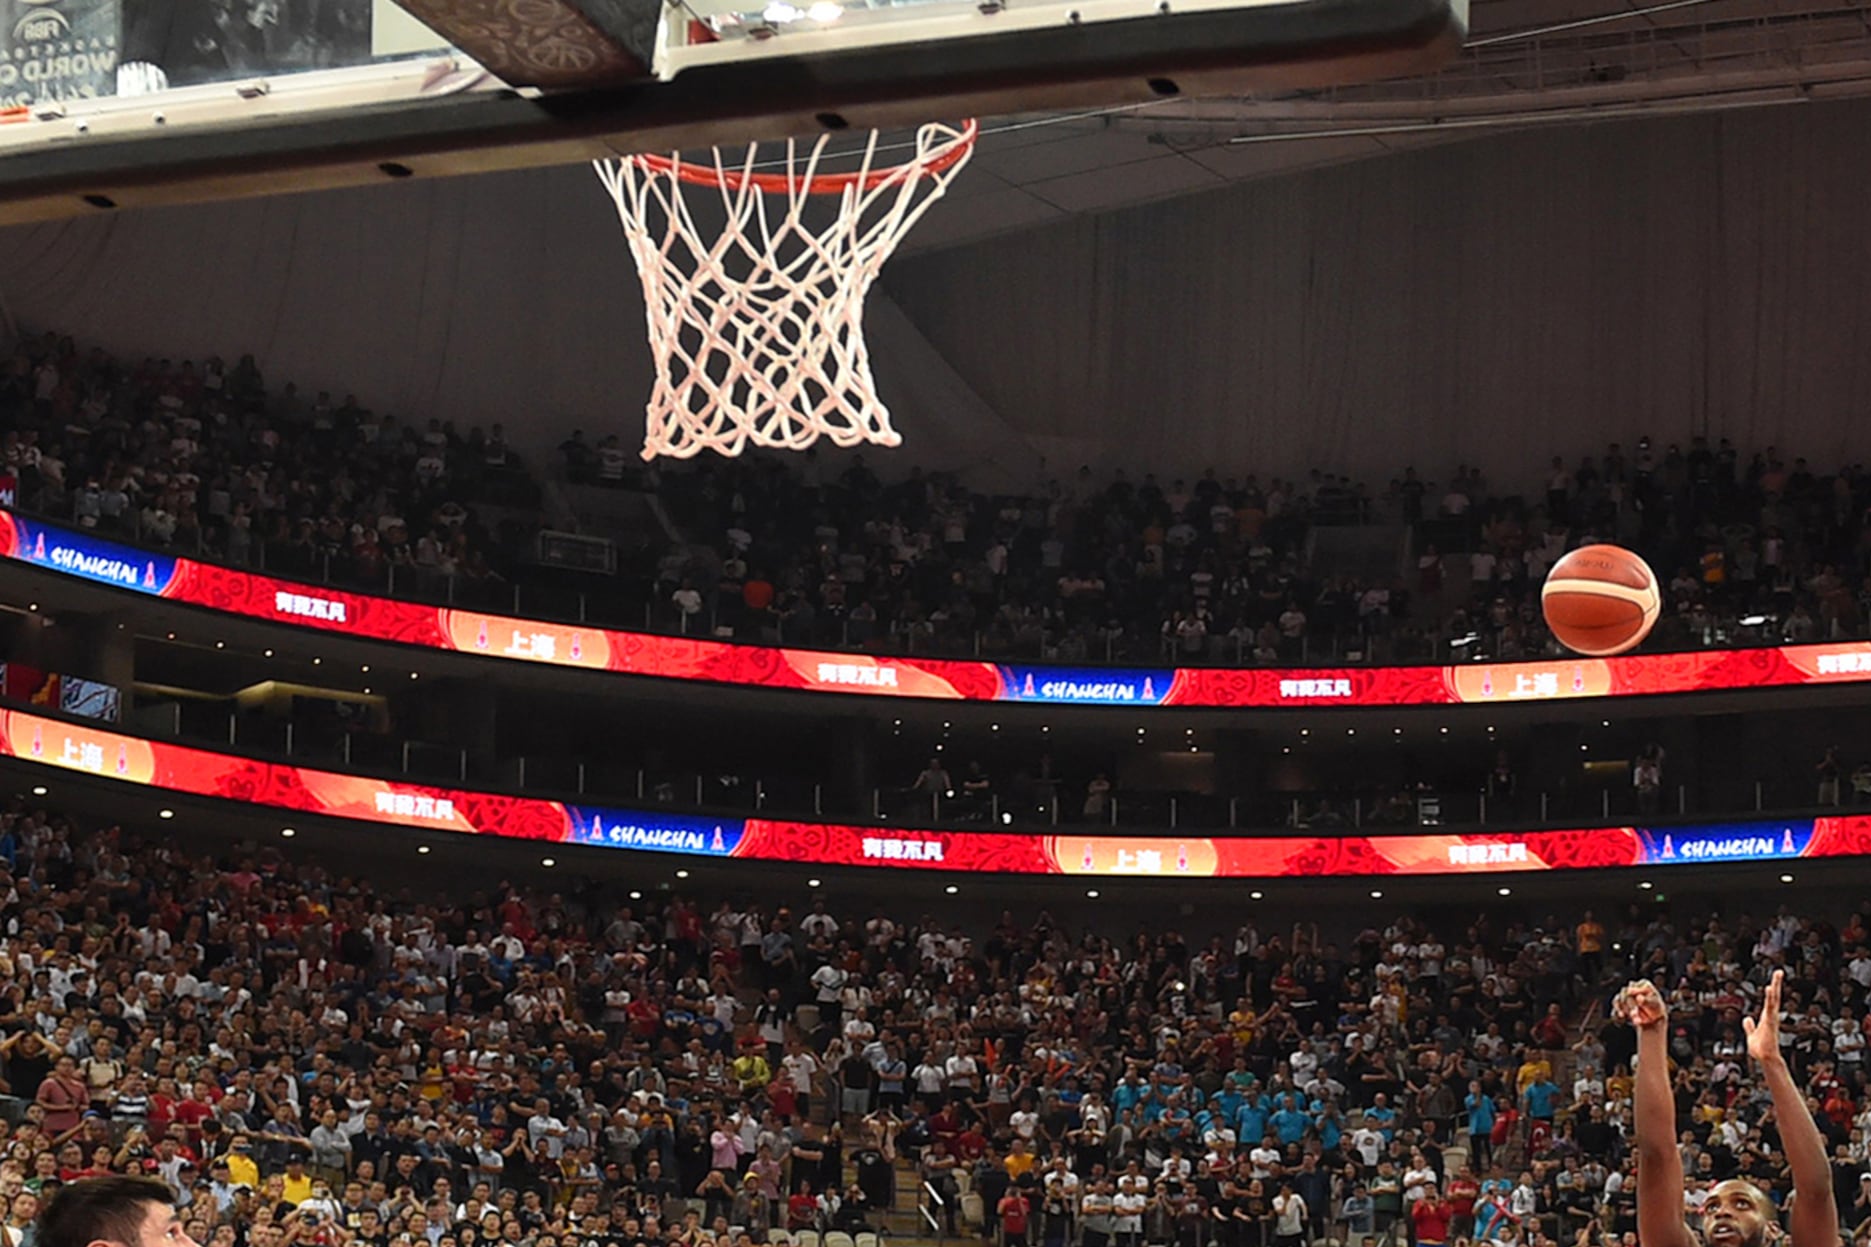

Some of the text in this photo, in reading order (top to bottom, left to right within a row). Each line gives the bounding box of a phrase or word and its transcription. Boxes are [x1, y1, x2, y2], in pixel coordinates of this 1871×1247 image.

[51, 544, 138, 584] SHANGHAI
[505, 631, 556, 661] 上海
[1040, 682, 1135, 700] SHANGHAI
[1508, 673, 1559, 696] 上海
[57, 736, 104, 770] 上海
[609, 823, 704, 850] SHANGHAI
[1681, 838, 1774, 857] SHANGHAI
[1110, 849, 1163, 873] 上海
